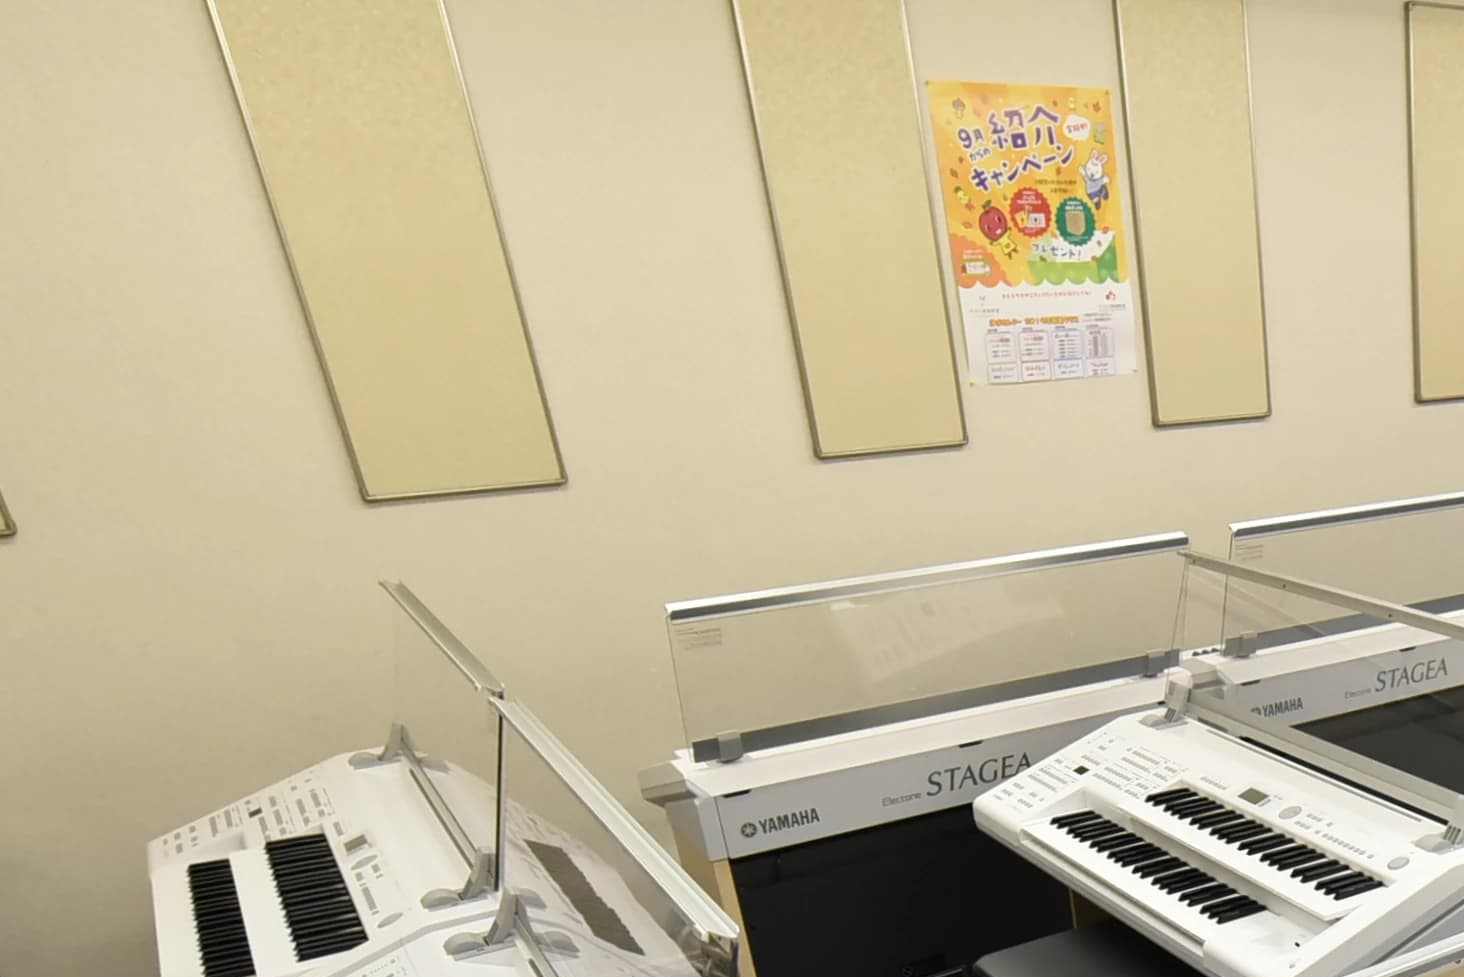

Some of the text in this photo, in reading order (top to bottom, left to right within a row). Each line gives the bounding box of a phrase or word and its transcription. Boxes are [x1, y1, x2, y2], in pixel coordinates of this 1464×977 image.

[988, 106, 1059, 149] 紹介
[971, 145, 1074, 191] キャンペーン
[1374, 657, 1449, 693] STAGEA
[1261, 697, 1304, 718] YAMAHA
[881, 751, 1032, 807] Electone STAGEA
[758, 807, 821, 835] YAMAHA
